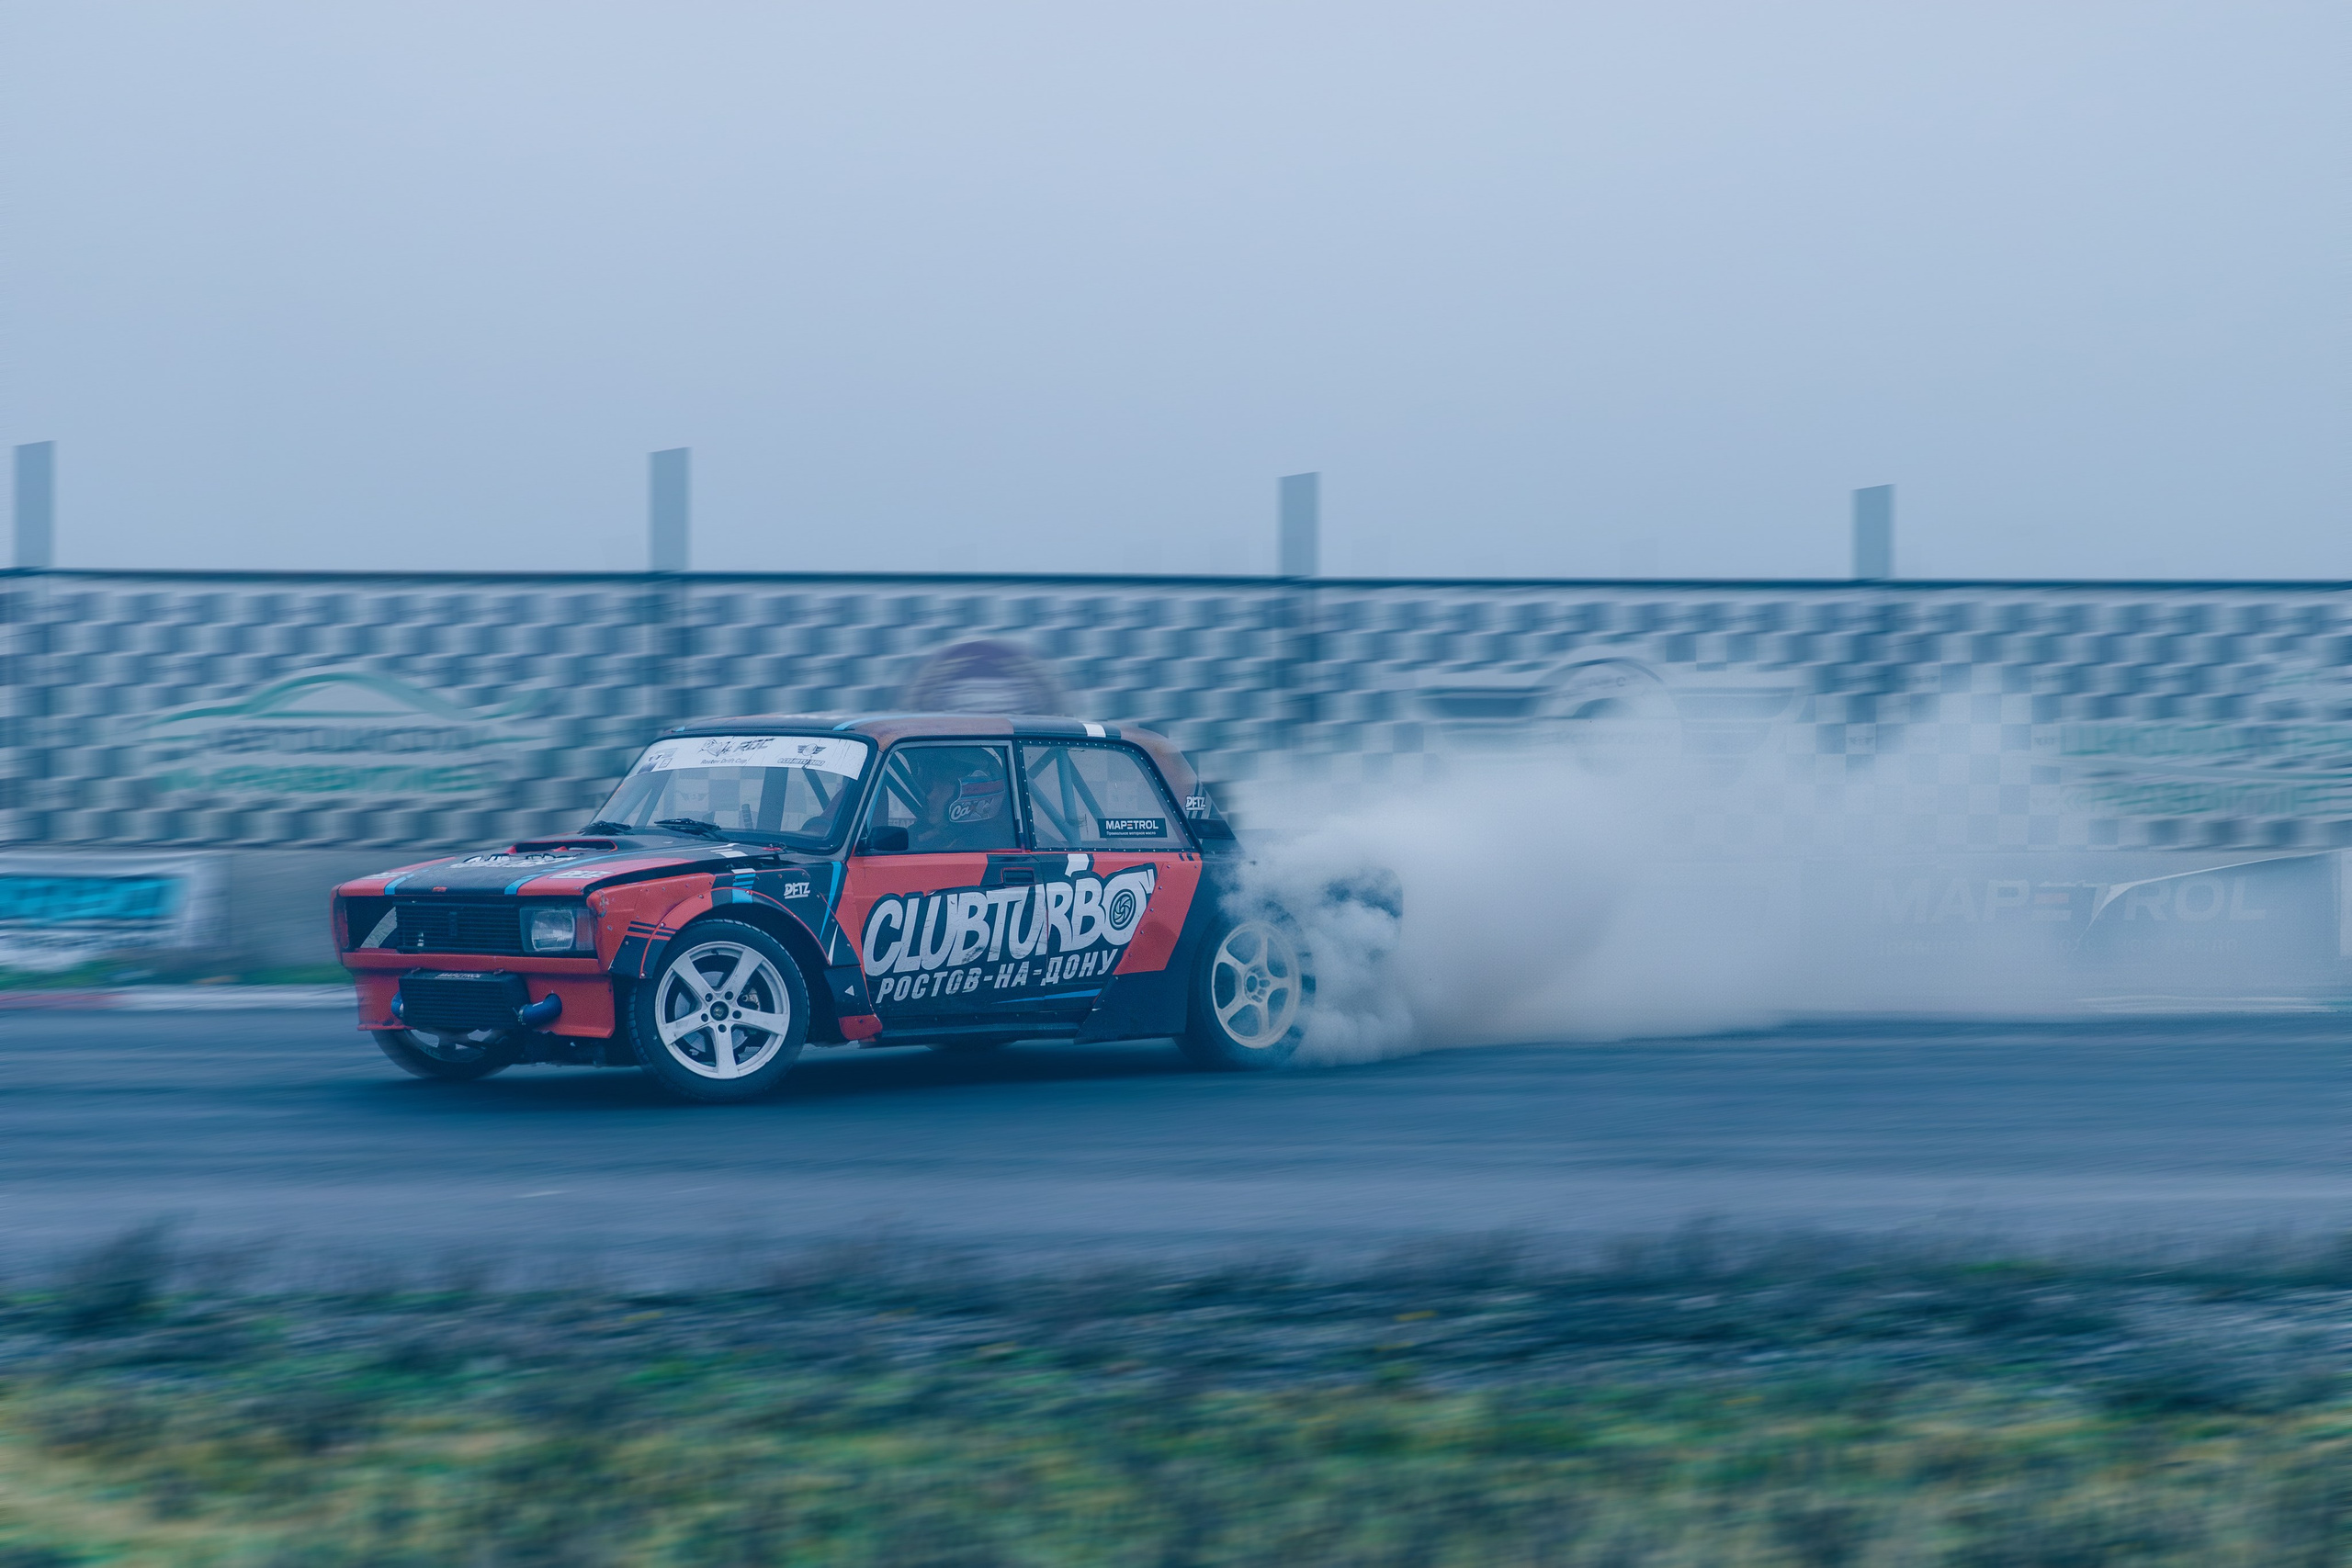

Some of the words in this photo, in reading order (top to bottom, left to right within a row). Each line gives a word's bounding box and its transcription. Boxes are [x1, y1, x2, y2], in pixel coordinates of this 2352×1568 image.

[1105, 819, 1159, 829] MAPETROL
[862, 869, 1154, 976] CLUBTURBO
[875, 949, 1119, 1004] РОСТОВ-НА-ДОНУ
